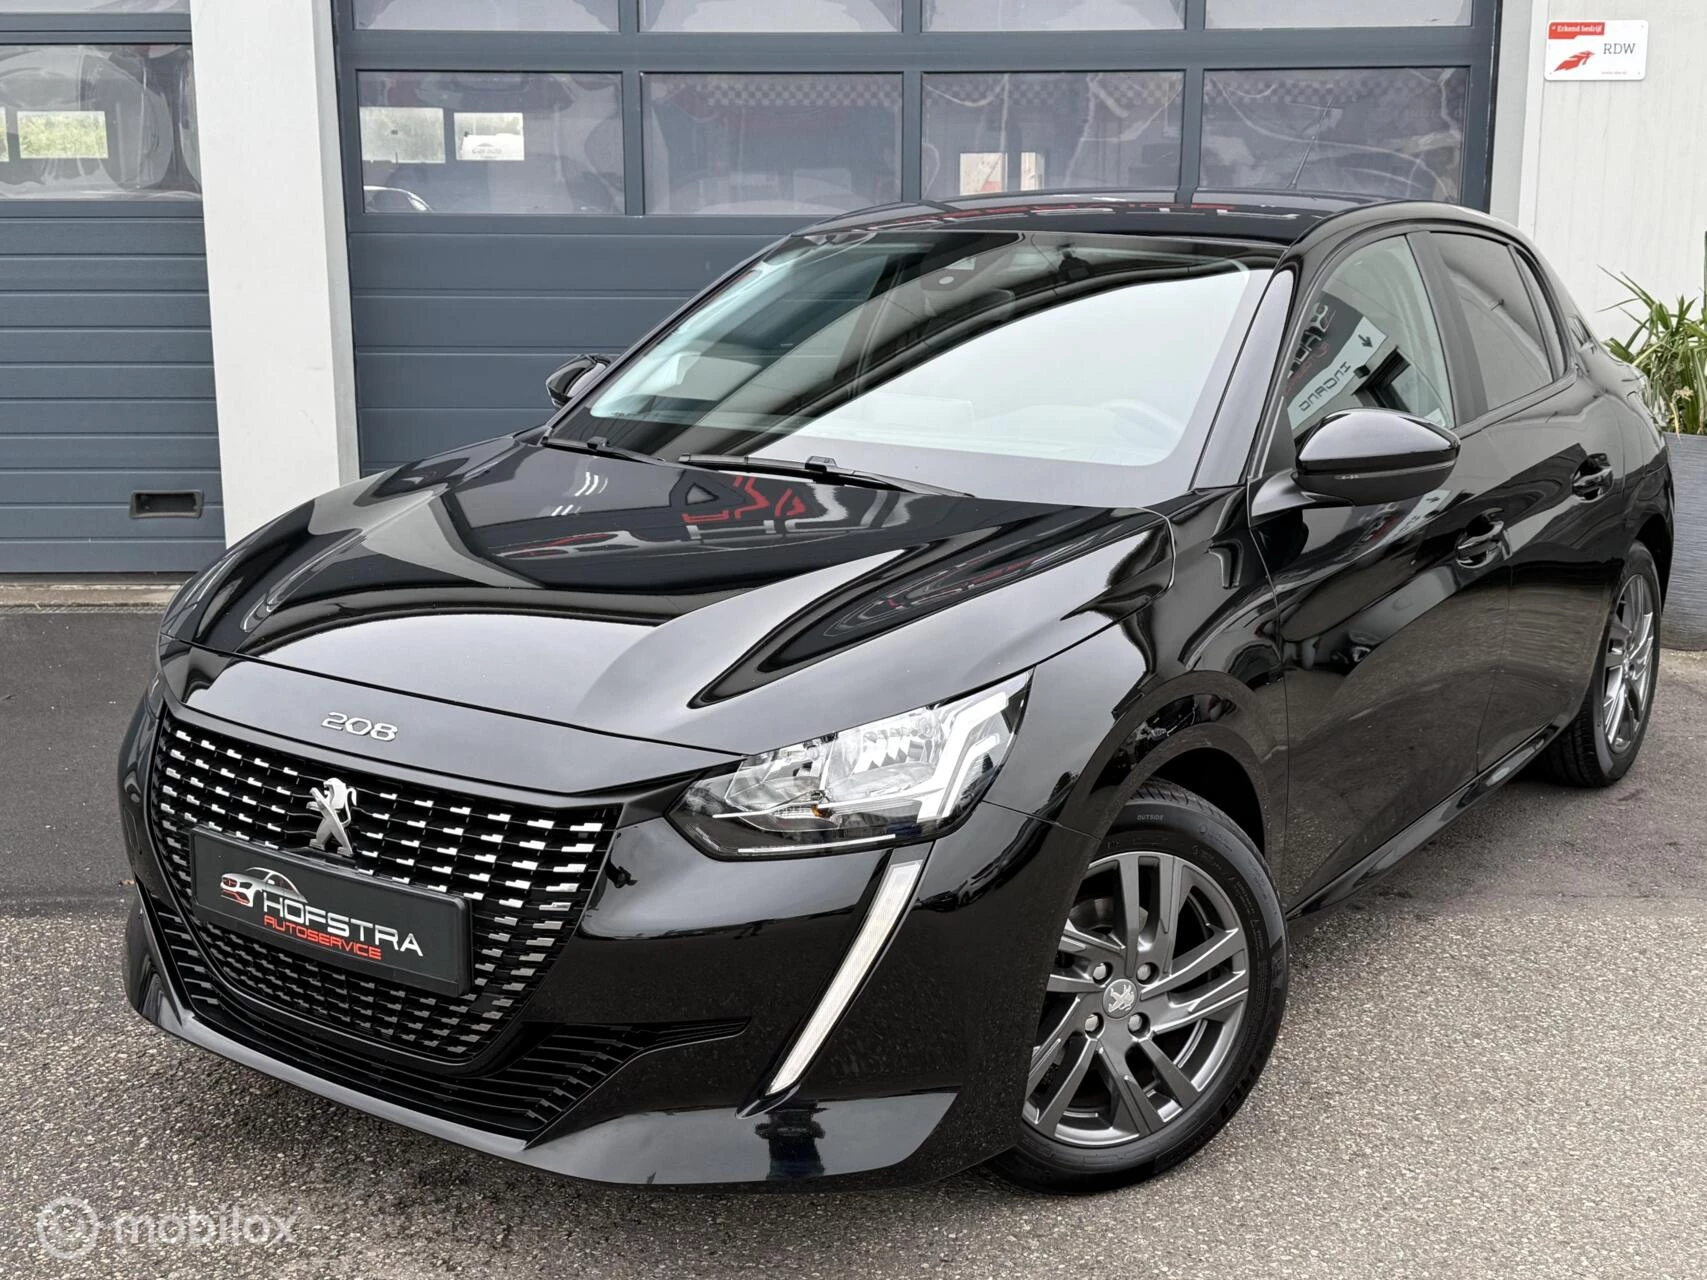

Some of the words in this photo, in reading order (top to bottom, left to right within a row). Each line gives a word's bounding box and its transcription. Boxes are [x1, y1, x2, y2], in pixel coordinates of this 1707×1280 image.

[1603, 43, 1636, 55] RDW
[321, 711, 398, 742] 208
[263, 891, 424, 957] HOFSTRA
[263, 914, 382, 961] AUTOSERVICE
